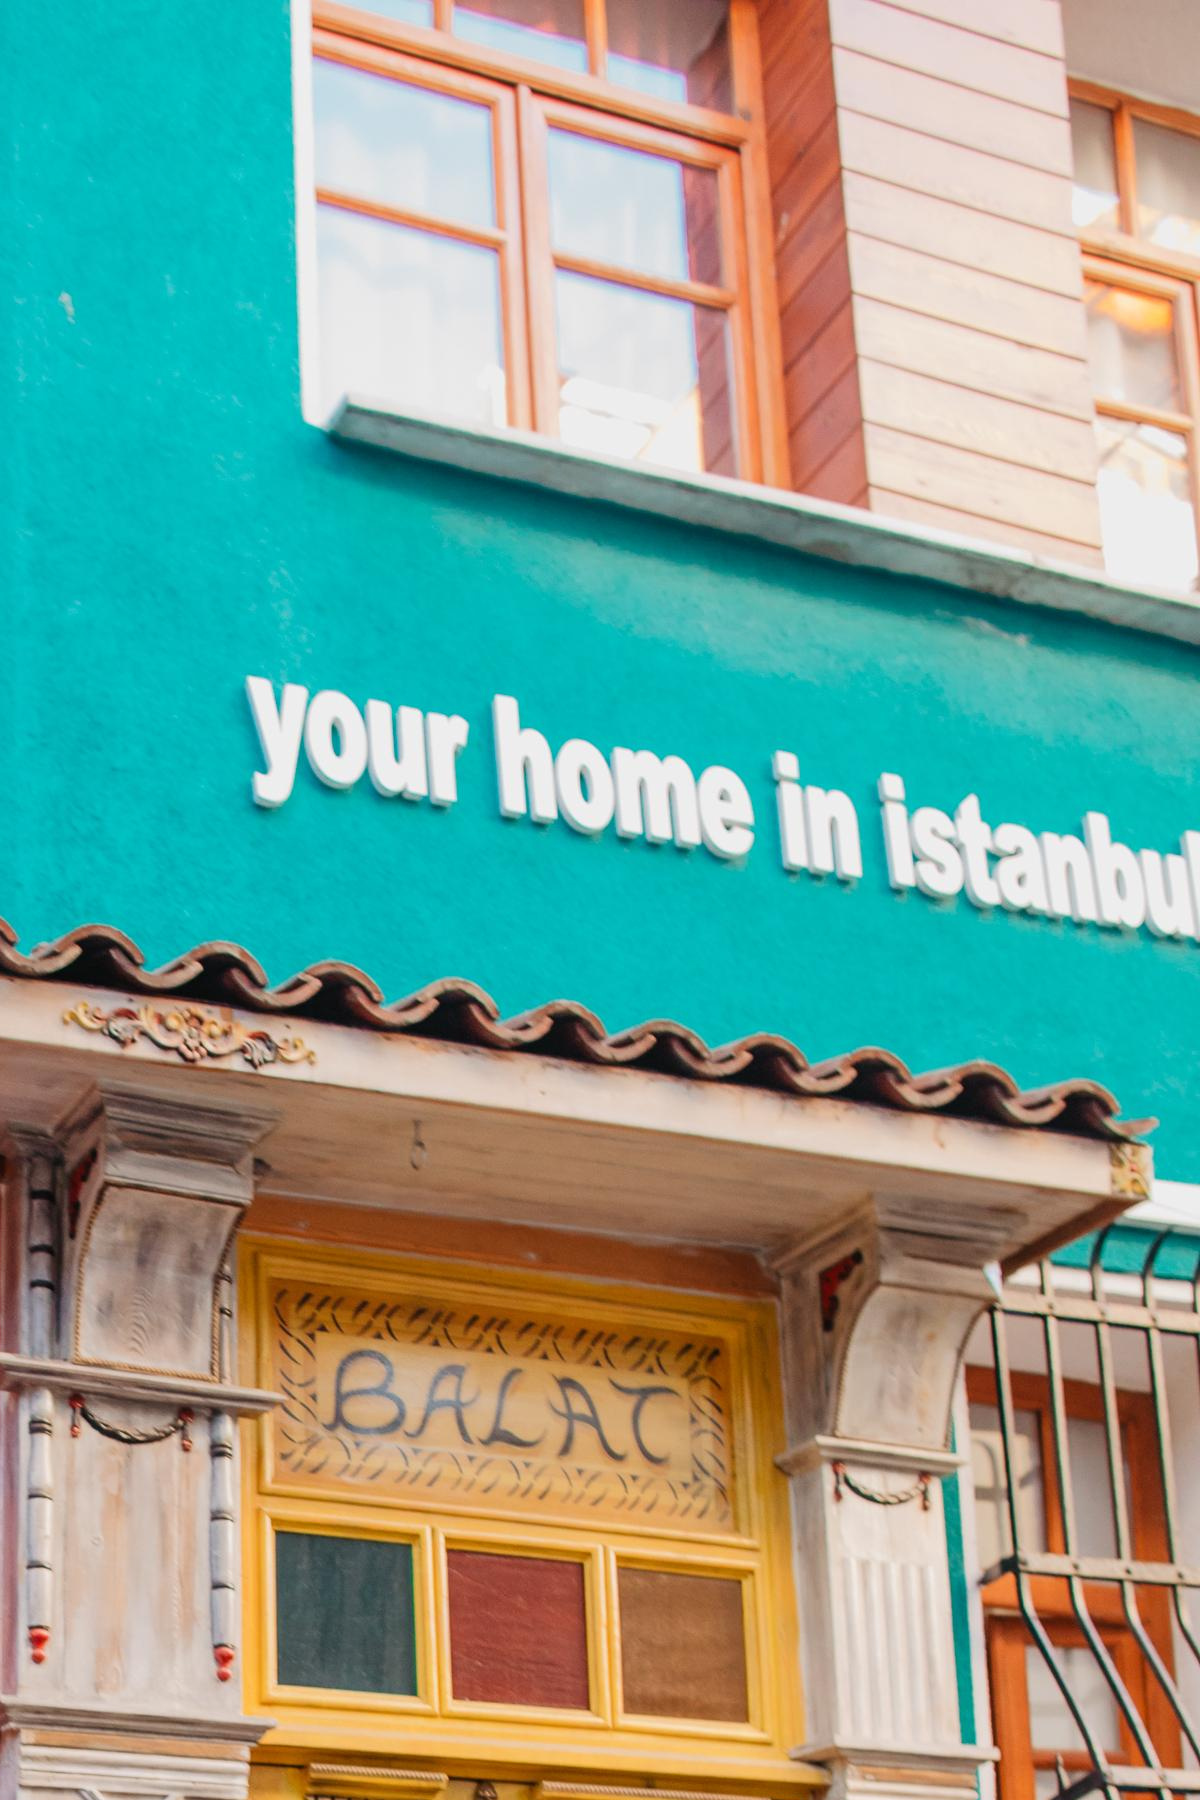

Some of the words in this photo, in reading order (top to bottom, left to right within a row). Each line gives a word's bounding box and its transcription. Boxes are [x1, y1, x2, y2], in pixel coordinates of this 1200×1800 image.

[246, 674, 469, 808] your
[493, 694, 755, 860] home
[772, 750, 863, 882] in
[321, 1349, 680, 1466] BALAT
